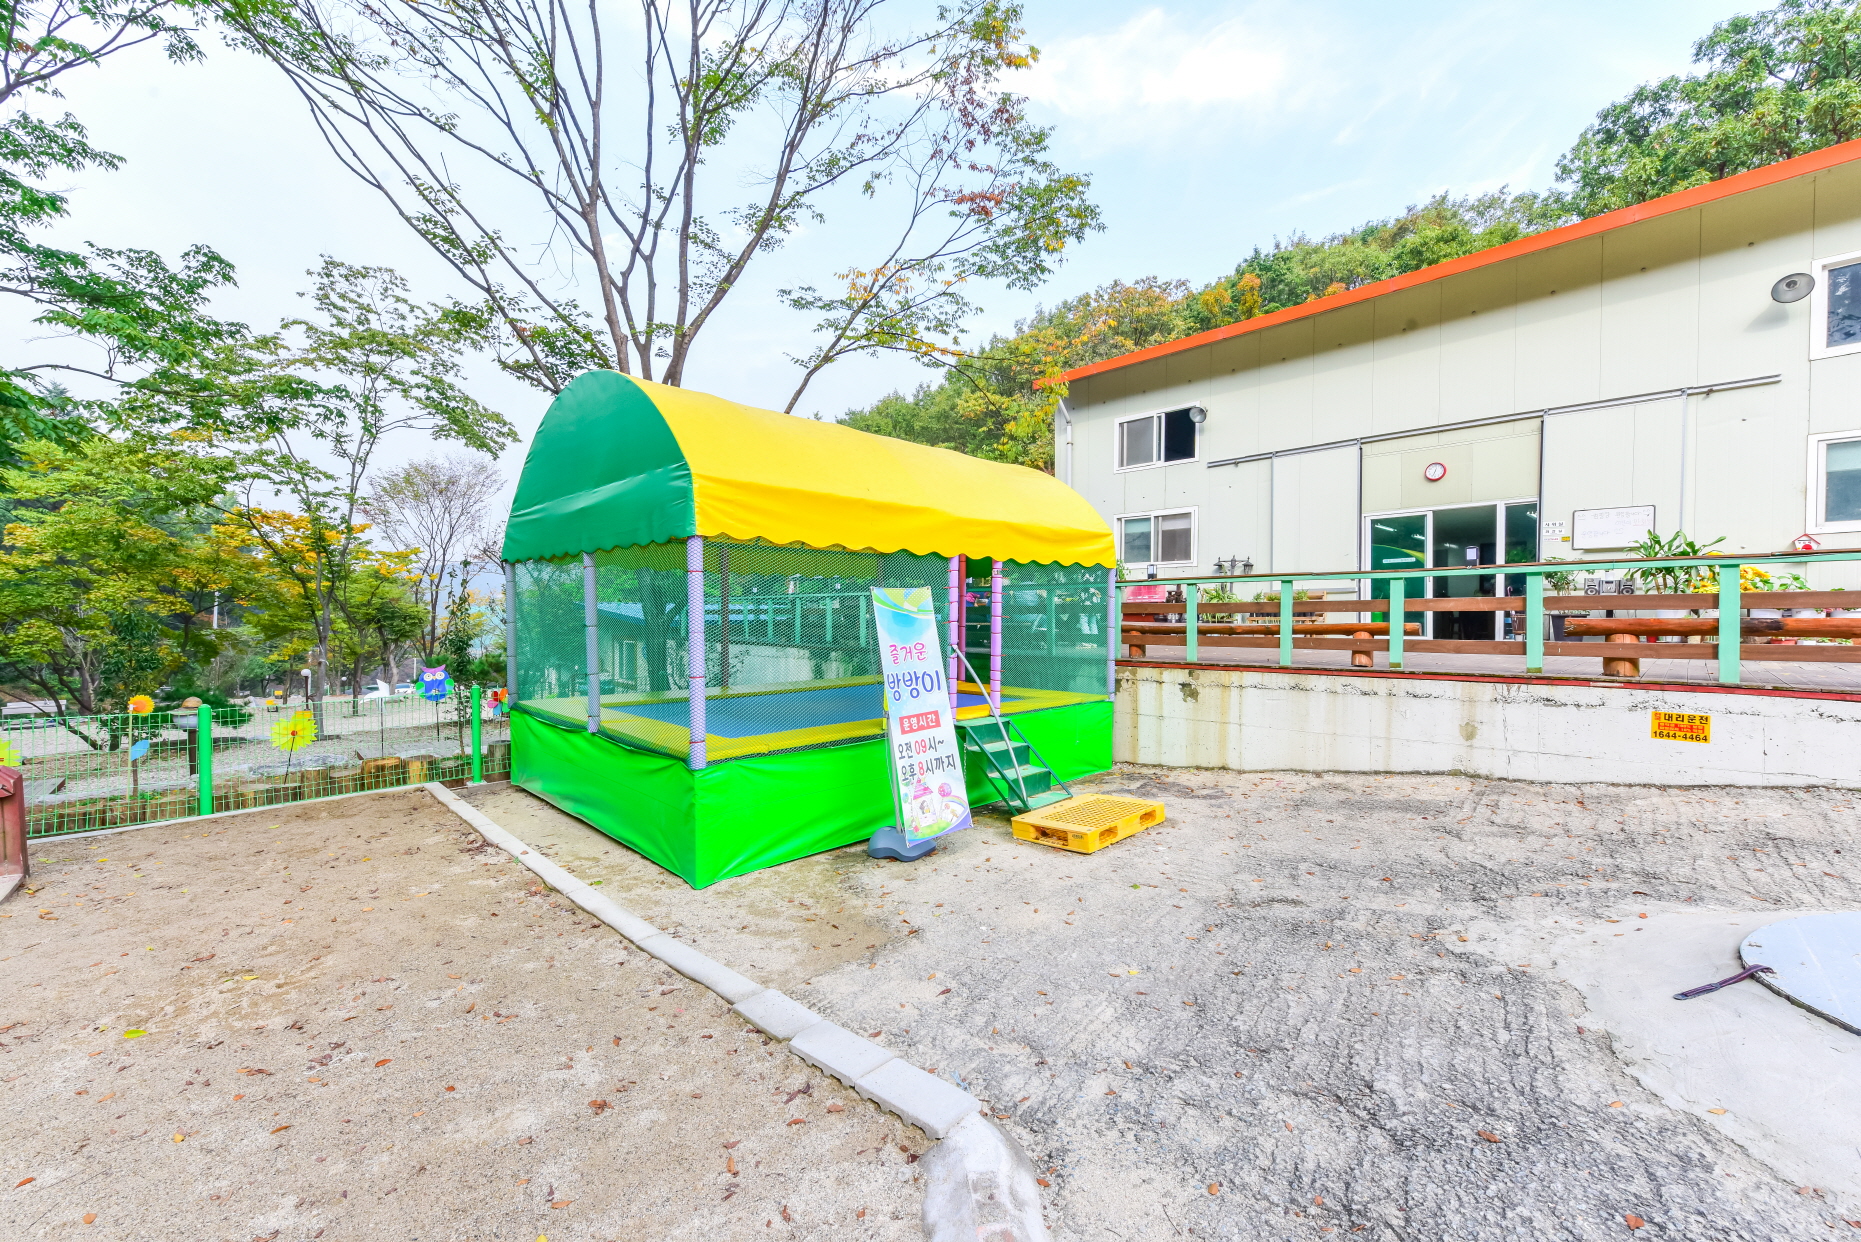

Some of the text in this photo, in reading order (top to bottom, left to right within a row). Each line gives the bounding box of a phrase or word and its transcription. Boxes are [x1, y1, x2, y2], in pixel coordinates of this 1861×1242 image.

[889, 642, 926, 665] 즐거운
[887, 670, 941, 702] 방방이
[903, 713, 936, 731] 운영시간
[1664, 713, 1708, 725] 대리운전
[1653, 730, 1708, 742] 1644-4464
[898, 741, 914, 760] 오전
[901, 753, 956, 782] 오후 8시까지
